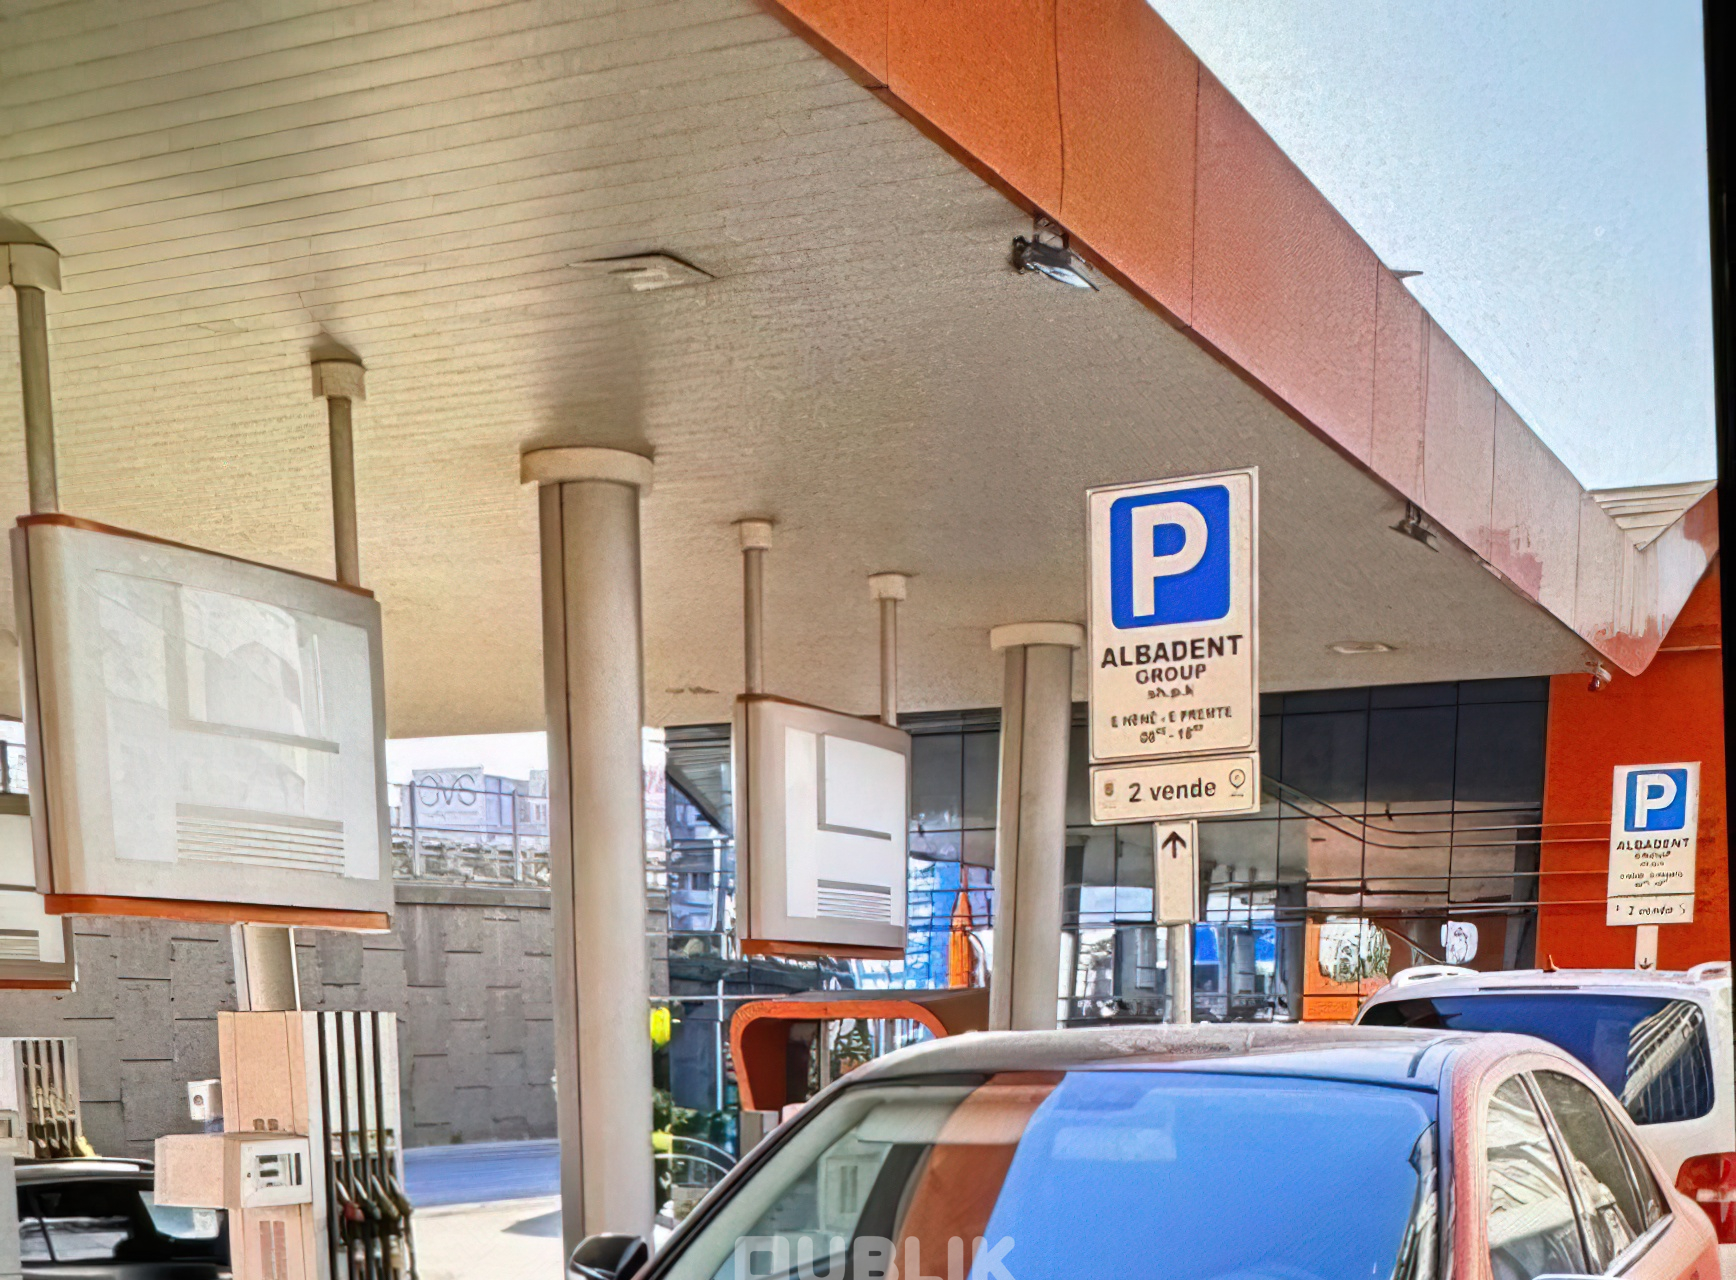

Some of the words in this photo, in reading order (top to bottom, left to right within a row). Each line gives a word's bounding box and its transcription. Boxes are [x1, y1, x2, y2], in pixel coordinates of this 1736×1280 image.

[1131, 501, 1209, 617] P
[1100, 634, 1244, 669] ALBADENT
[1135, 663, 1207, 685] GROUP
[1128, 782, 1142, 803] 2
[1149, 777, 1217, 801] vende
[1634, 773, 1678, 828] P
